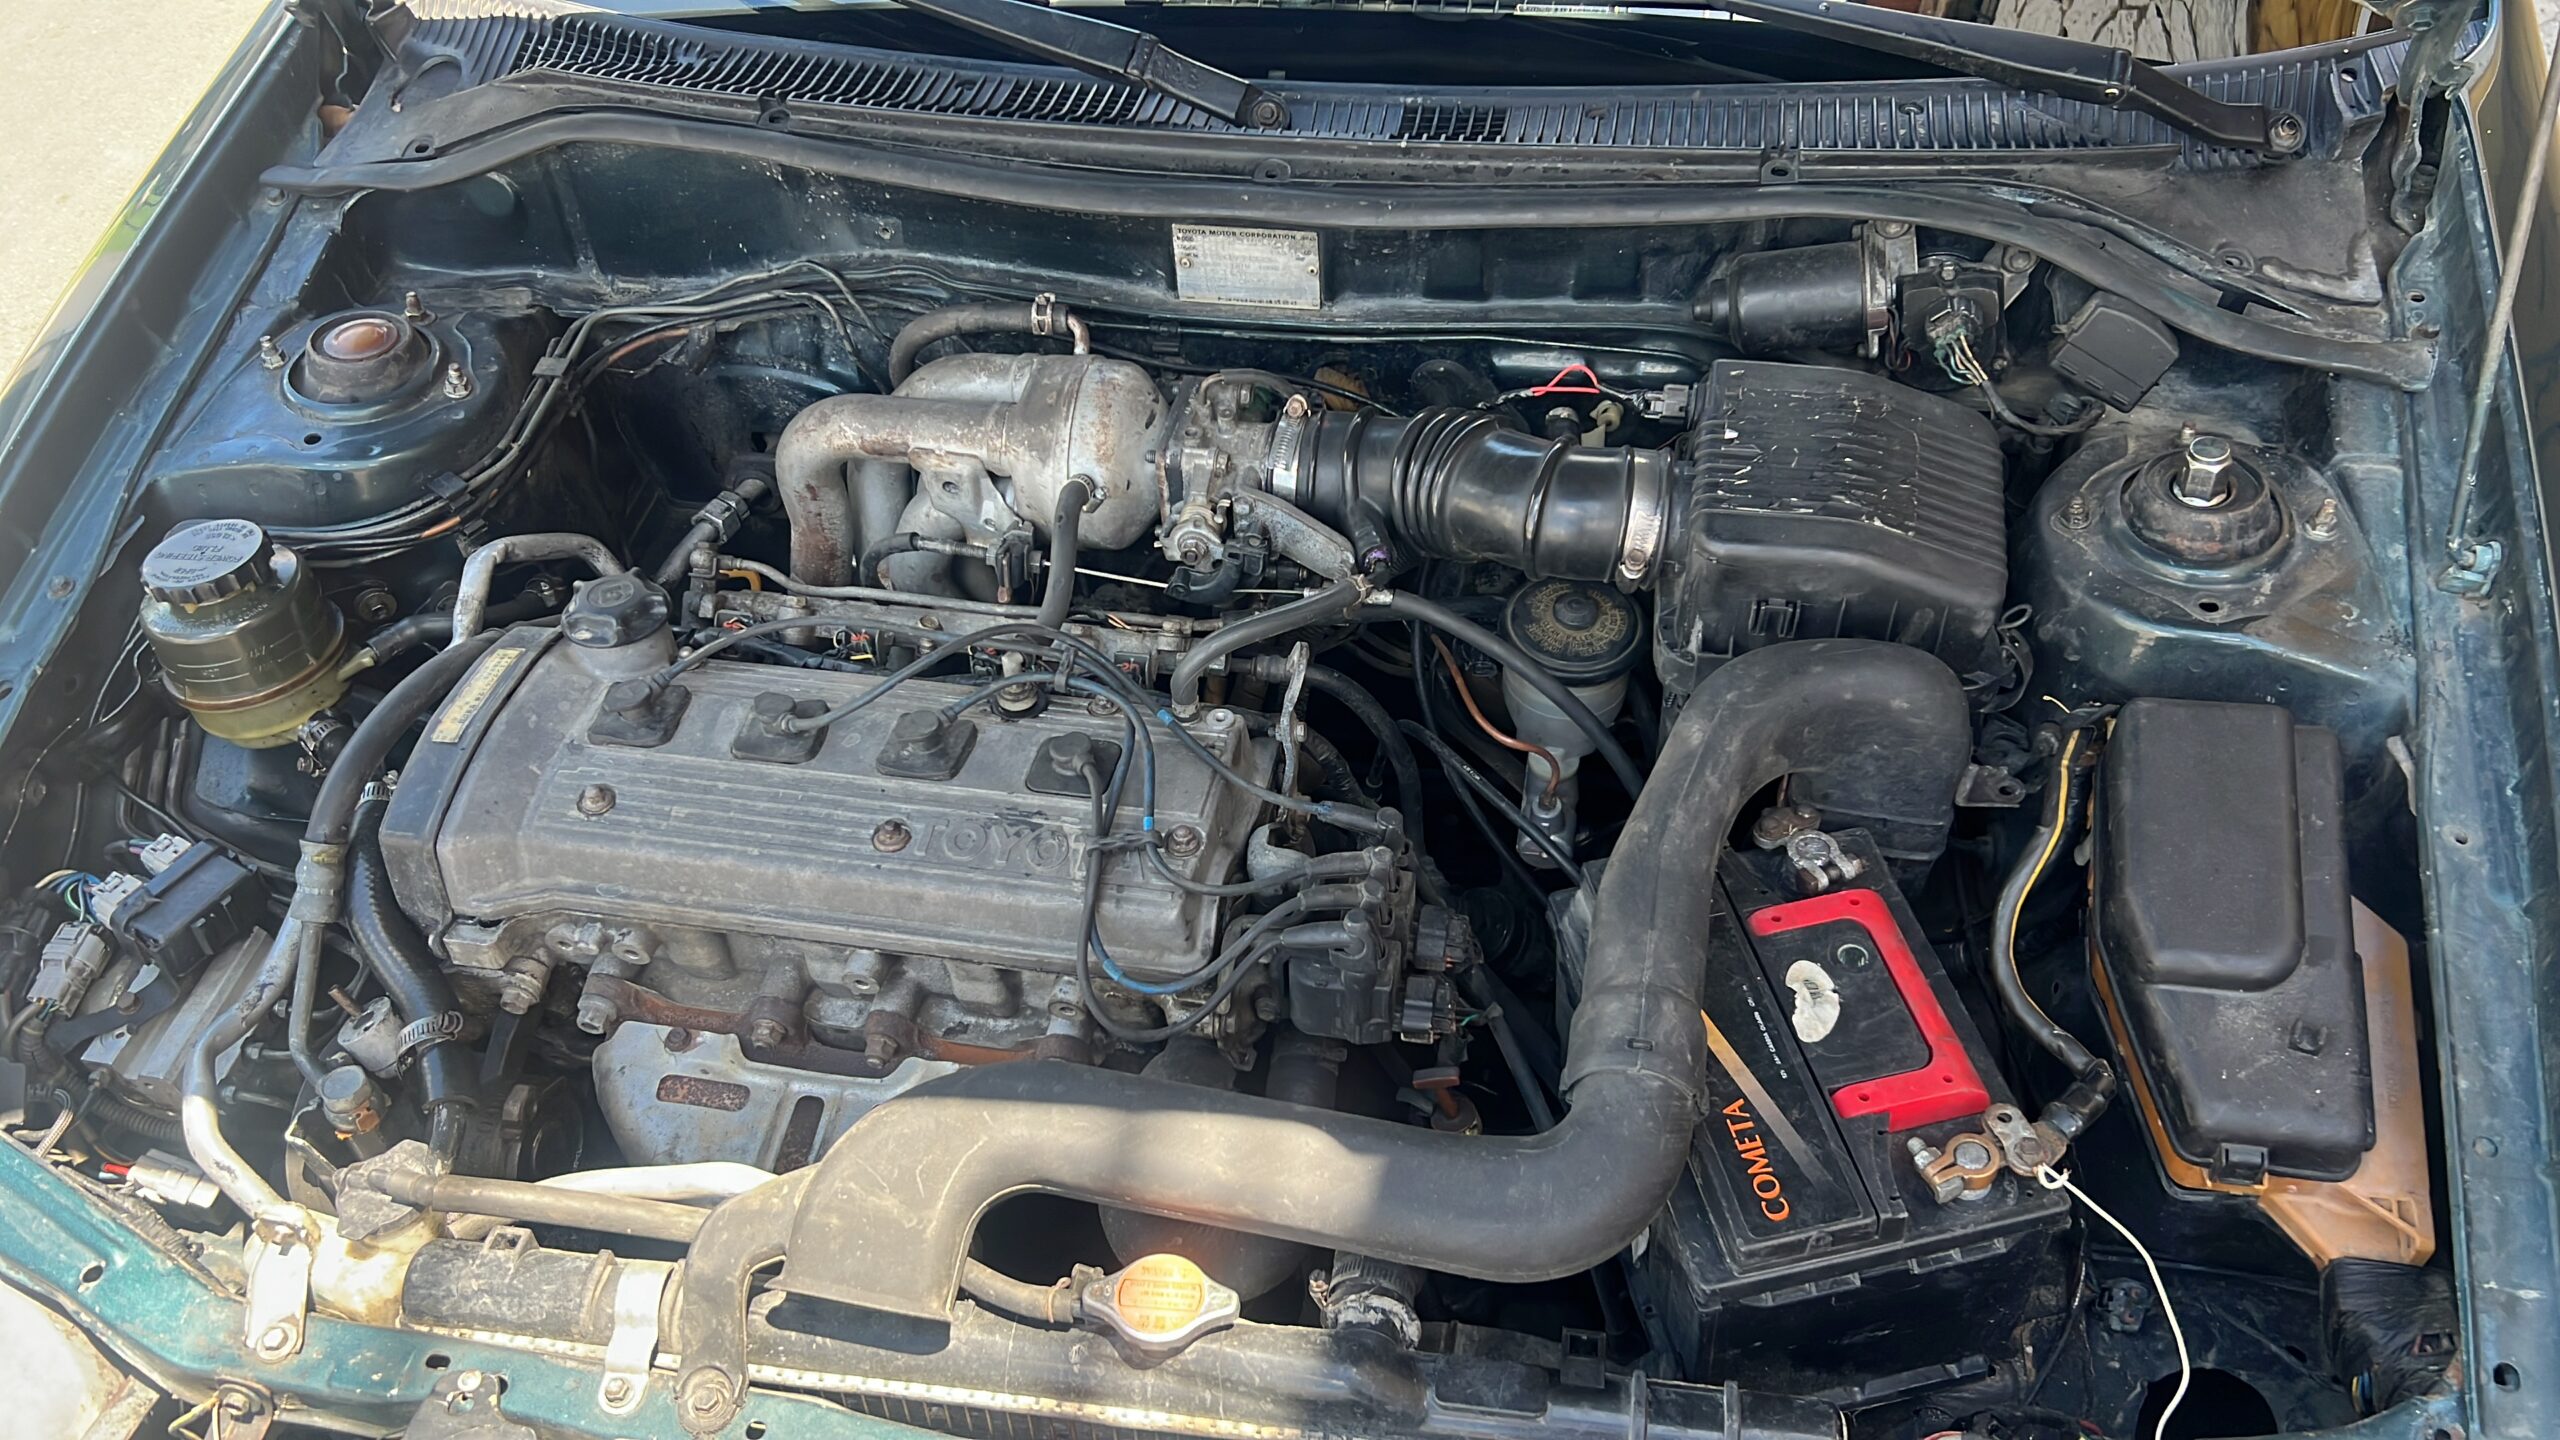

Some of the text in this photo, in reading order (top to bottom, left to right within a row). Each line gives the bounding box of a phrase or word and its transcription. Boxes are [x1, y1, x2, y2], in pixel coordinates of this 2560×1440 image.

[1177, 228, 1206, 236] TOYOTA
[1209, 229, 1237, 237] MOTOR
[1240, 231, 1297, 241] CORPORATION
[154, 551, 244, 563] POWER STEERING
[1721, 1098, 1790, 1222] COMETA
